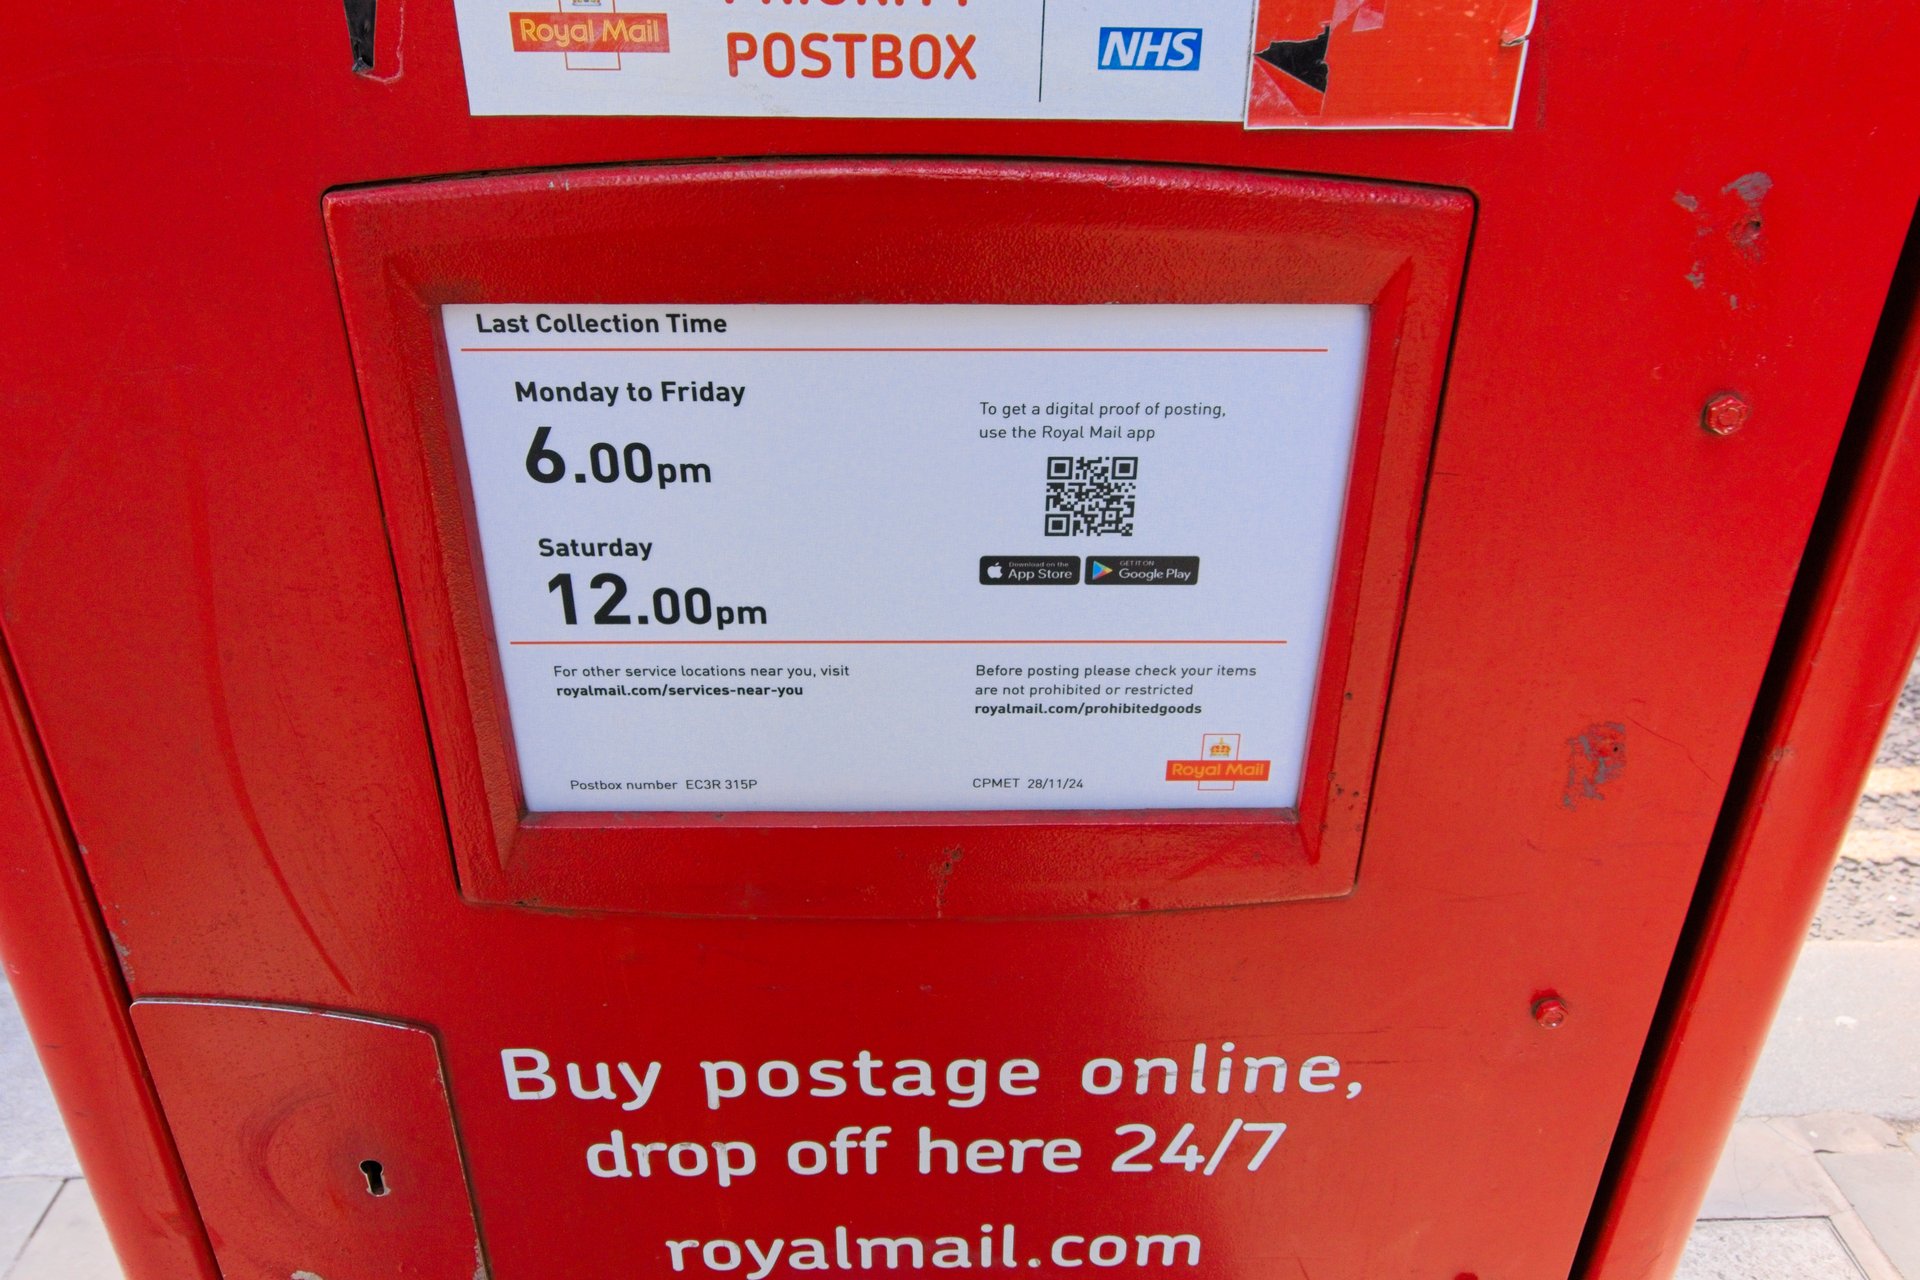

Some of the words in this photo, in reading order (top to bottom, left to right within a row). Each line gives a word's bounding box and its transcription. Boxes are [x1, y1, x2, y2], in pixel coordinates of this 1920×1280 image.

[520, 19, 596, 48] Royal
[600, 19, 660, 43] Mail
[727, 32, 976, 79] POSTBOX
[1101, 31, 1197, 68] NHS
[475, 313, 530, 334] Last
[535, 313, 660, 334] Collection
[665, 313, 727, 334] Time
[515, 382, 619, 407] Monday
[626, 382, 653, 402] to
[661, 381, 745, 407] Friday
[979, 401, 997, 416] To
[1002, 402, 1027, 419] get
[1031, 405, 1041, 416] a
[1045, 401, 1094, 419] digital
[1099, 401, 1141, 419] proof
[1144, 401, 1161, 416] of
[1164, 402, 1226, 420] posting,
[979, 428, 1007, 439] use
[1011, 425, 1037, 439] the
[1042, 425, 1085, 442] Royal
[1089, 425, 1122, 439] Mail
[1126, 428, 1156, 442] app
[526, 427, 711, 489] 6.00pm
[539, 538, 652, 561] Saturday
[1008, 568, 1035, 581] App
[1038, 568, 1073, 579] Store
[1118, 567, 1164, 582] Google
[1165, 568, 1192, 582] Play
[549, 573, 766, 630] 12.00pm
[553, 665, 578, 678] For
[582, 665, 621, 677] other
[625, 667, 677, 677] service
[680, 665, 746, 677] locations
[750, 667, 784, 677] near
[786, 667, 817, 680] you,
[820, 664, 850, 677] visit
[976, 664, 1023, 677] Before
[1027, 664, 1080, 680] posting
[1084, 664, 1131, 679] please
[1134, 664, 1177, 677] check
[1180, 667, 1214, 679] your
[1216, 665, 1257, 677] items
[556, 683, 803, 699] royalmail.com/services-near-you
[975, 686, 998, 696] are
[1002, 685, 1025, 696] not
[1029, 683, 1101, 698] prohibited
[1105, 686, 1121, 696] or
[1124, 684, 1194, 696] restricted
[974, 702, 1202, 717] royalmail.com/prohibitedgoods
[1171, 762, 1222, 779] Royal
[1225, 762, 1265, 776] Mail
[570, 779, 623, 791] Postbox
[626, 779, 678, 790] number
[685, 779, 722, 790] EC3R
[724, 779, 758, 790] 315P
[972, 777, 1020, 789] CPMET
[1027, 777, 1084, 790] 28/11/24
[501, 1048, 661, 1111] Buy
[700, 1050, 1039, 1110] postage
[1082, 1042, 1362, 1099] online,
[587, 1130, 756, 1187] drop
[788, 1126, 891, 1175] off
[919, 1126, 1081, 1174] here
[1112, 1118, 1287, 1176] 24/7
[666, 1224, 1201, 1280] royalmail.com
